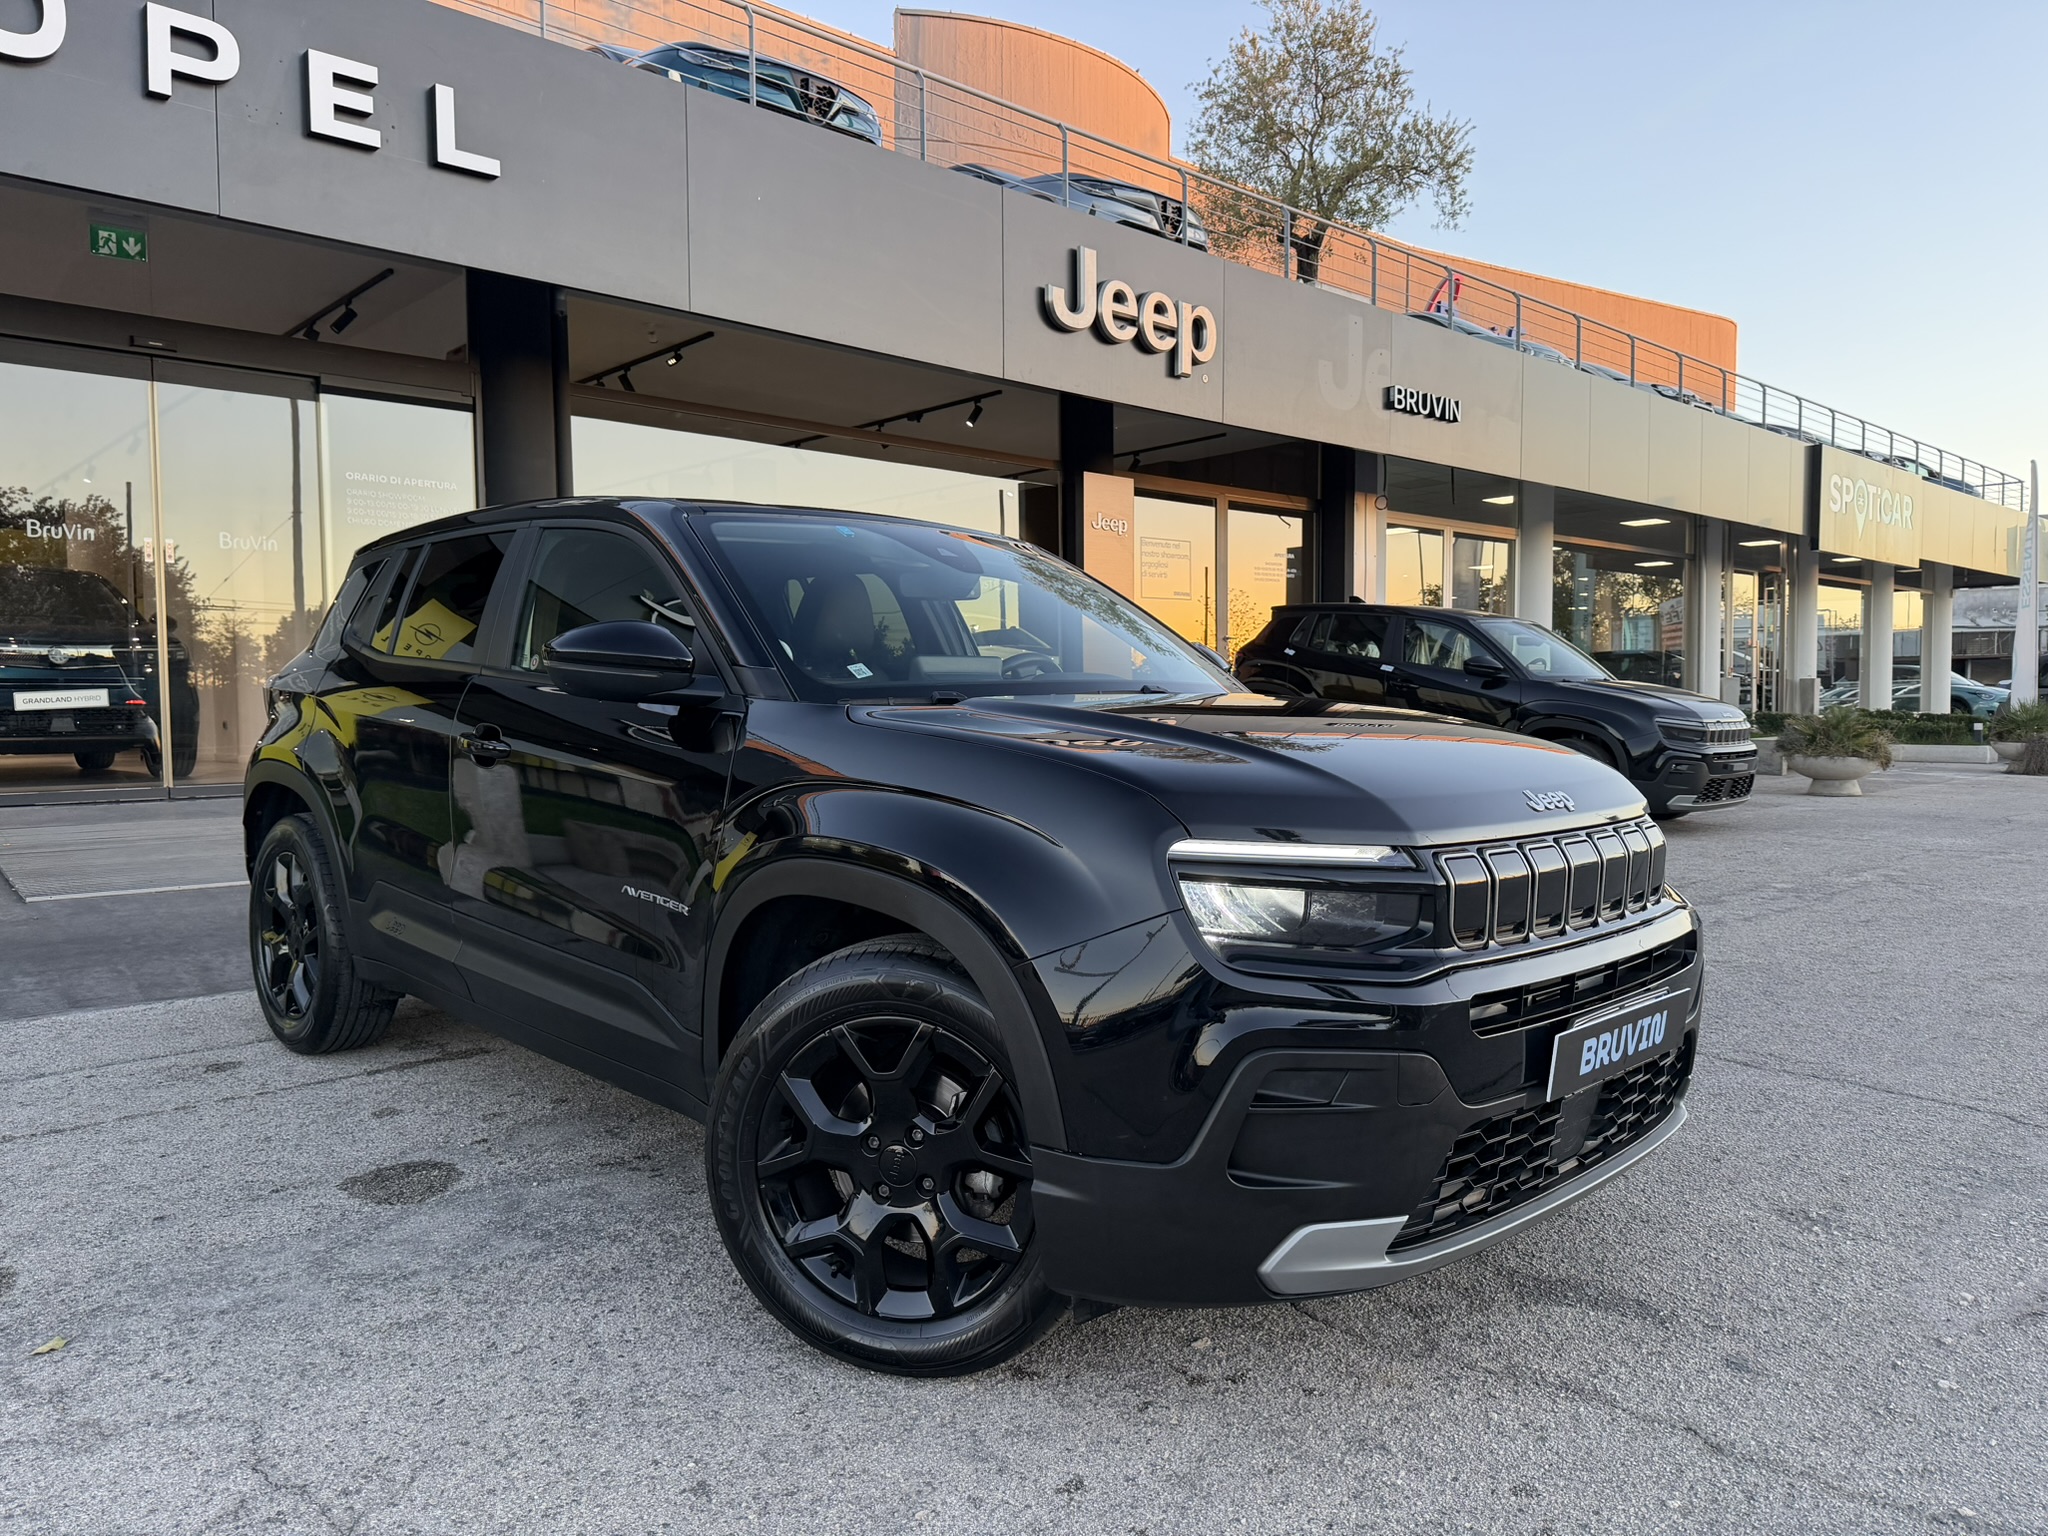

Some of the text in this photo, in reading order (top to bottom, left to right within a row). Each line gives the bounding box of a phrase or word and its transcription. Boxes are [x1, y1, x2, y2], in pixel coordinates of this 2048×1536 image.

[1044, 245, 1217, 378] Jeep
[1393, 384, 1462, 423] BRUVIN
[345, 471, 458, 491] ORARIO DI APERTURA
[26, 518, 96, 542] BruVin
[1091, 511, 1128, 536] Jeep
[219, 531, 278, 552] BruVin
[22, 696, 73, 705] GRANDLAND
[1522, 789, 1575, 813] Jeep
[621, 884, 690, 917] AVENGER
[1579, 1009, 1668, 1076] BRUVIN
[717, 1056, 756, 1220] GOODYEAR
